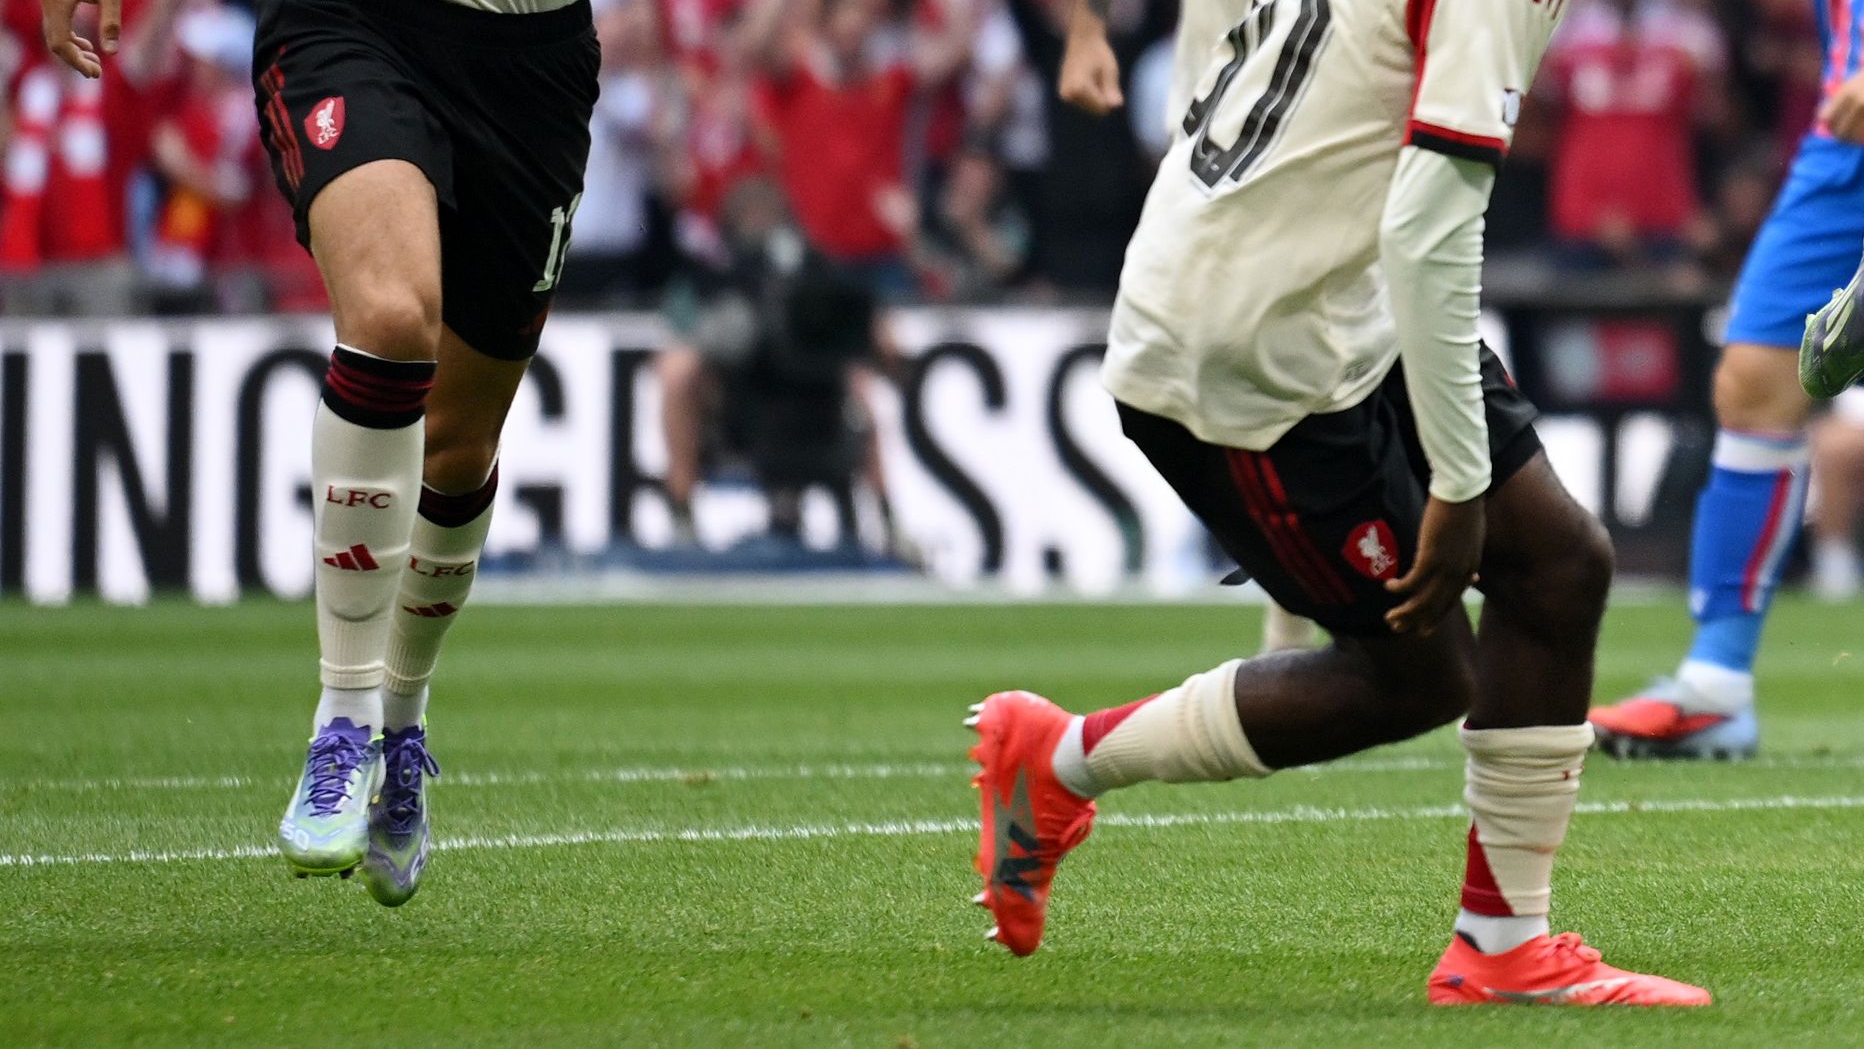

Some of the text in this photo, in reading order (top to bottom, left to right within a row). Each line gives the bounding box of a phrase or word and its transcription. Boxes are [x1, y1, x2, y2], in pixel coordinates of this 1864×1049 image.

[532, 192, 582, 292] 1
[326, 485, 391, 509] LFC
[408, 555, 474, 578] LFC
